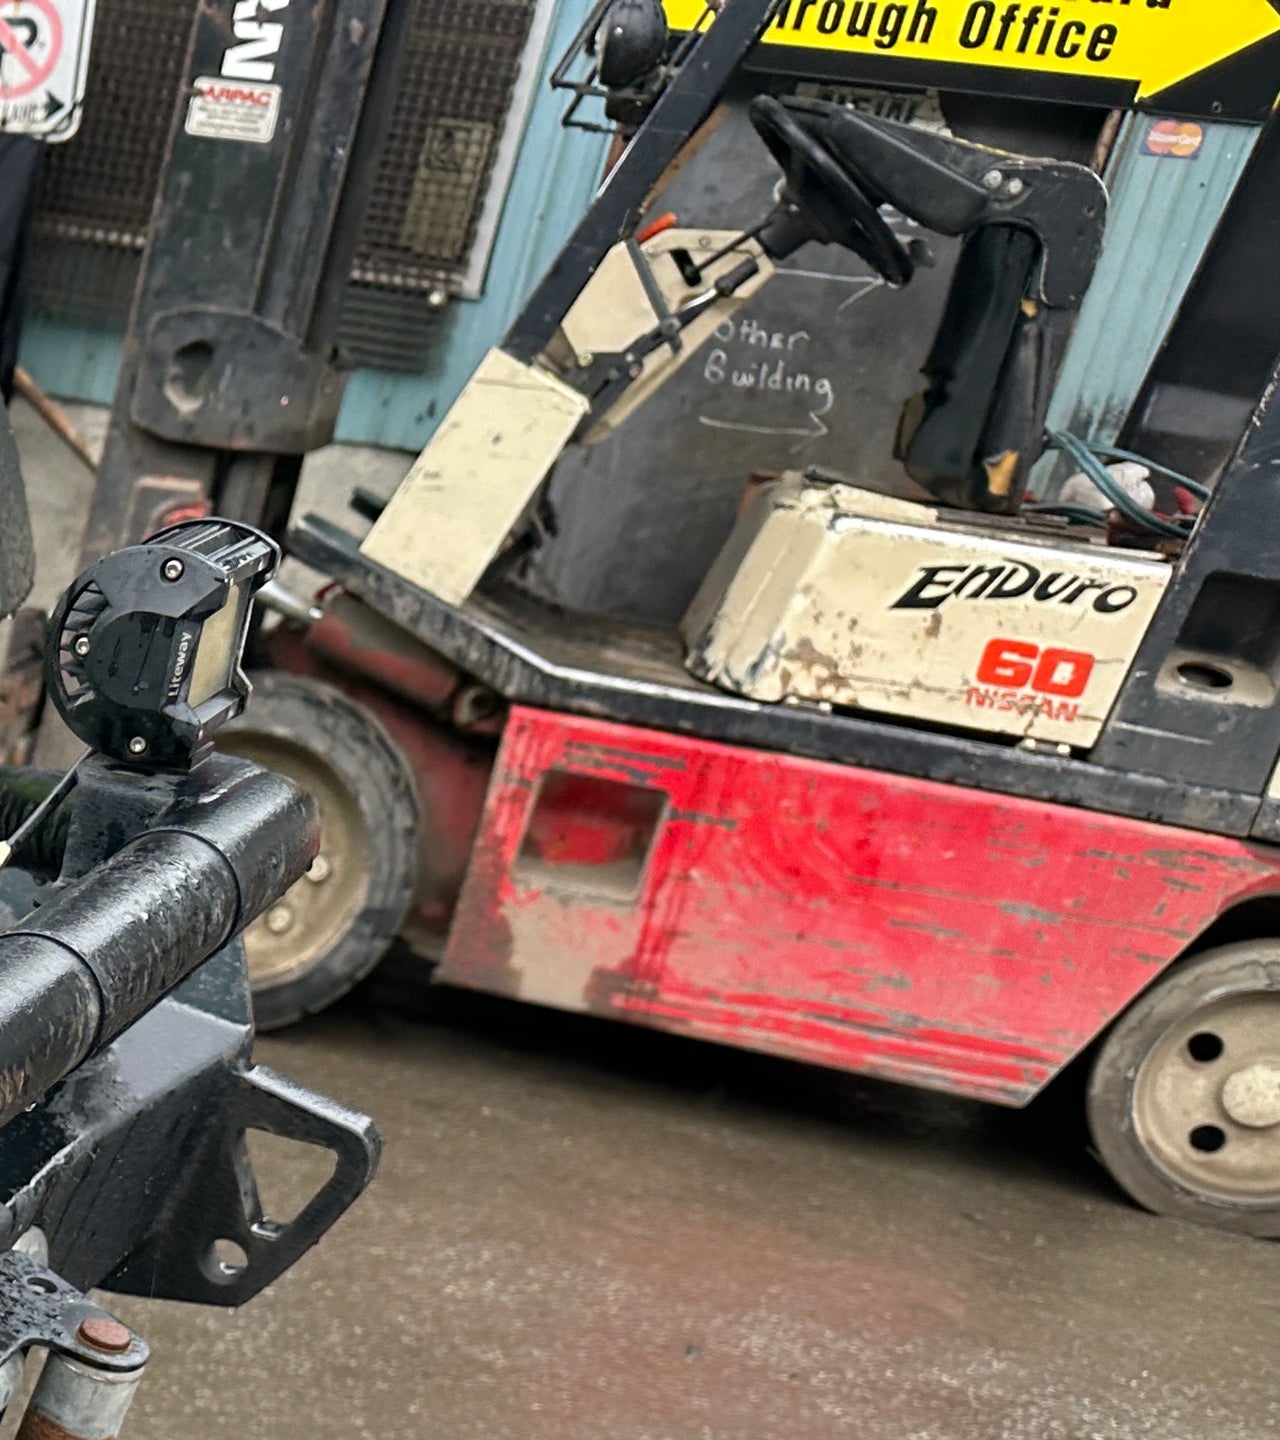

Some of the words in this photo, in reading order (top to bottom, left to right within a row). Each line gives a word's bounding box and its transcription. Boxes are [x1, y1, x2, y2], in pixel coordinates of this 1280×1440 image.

[958, 0, 1118, 62] Office
[714, 319, 810, 350] Other
[704, 348, 833, 413] Building
[168, 631, 192, 697] Liteway
[976, 637, 1095, 699] 60
[965, 686, 1079, 722] NISSAN
